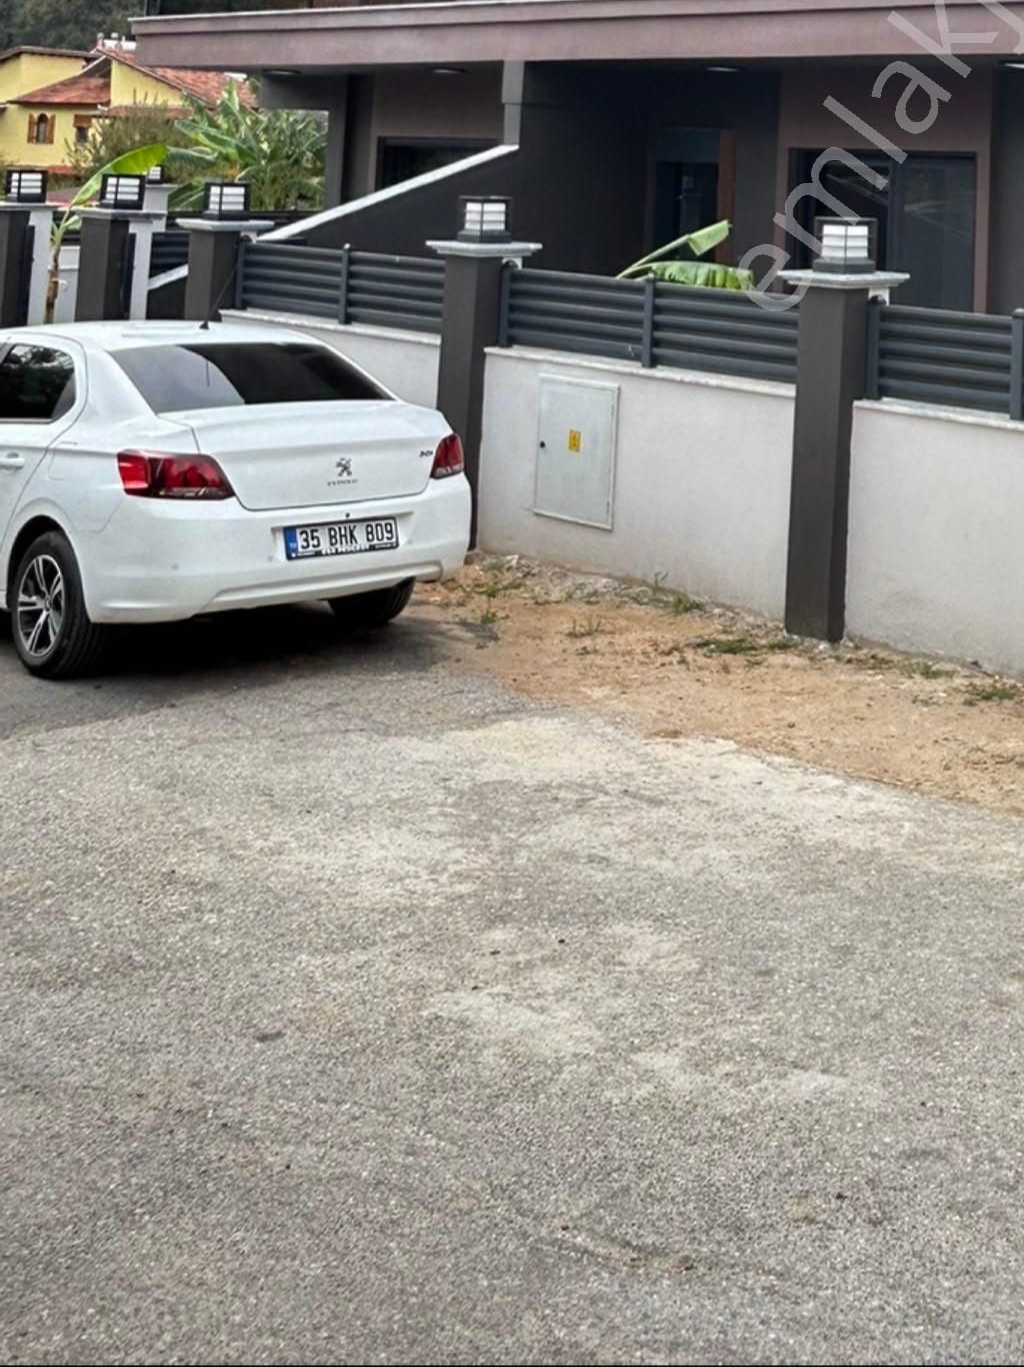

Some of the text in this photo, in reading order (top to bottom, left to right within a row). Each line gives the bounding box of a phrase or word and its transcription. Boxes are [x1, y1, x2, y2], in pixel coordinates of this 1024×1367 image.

[300, 529, 321, 550] 35
[328, 525, 358, 547] BHK
[366, 522, 394, 543] 809
